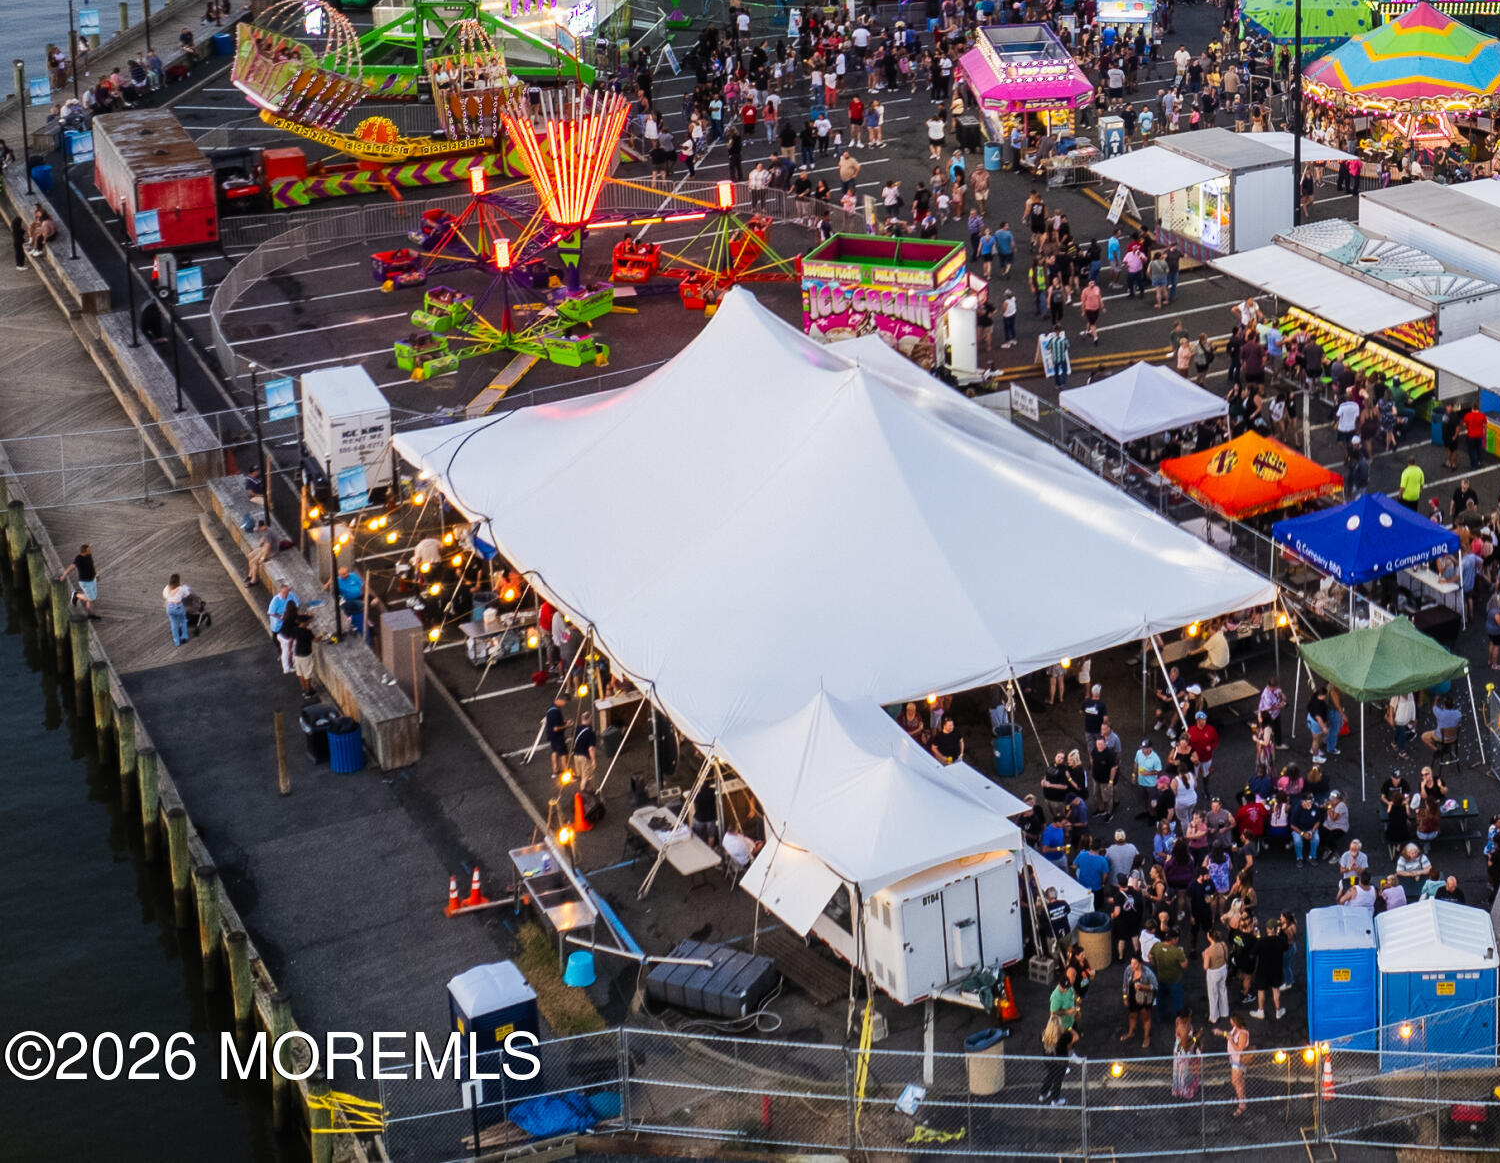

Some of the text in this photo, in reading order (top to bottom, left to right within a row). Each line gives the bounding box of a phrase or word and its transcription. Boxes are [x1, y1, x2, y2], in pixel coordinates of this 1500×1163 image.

[809, 285, 932, 331] ICE CREAM
[1295, 540, 1342, 579] Q Company BBQ
[1385, 542, 1449, 572] Q Company BBQ
